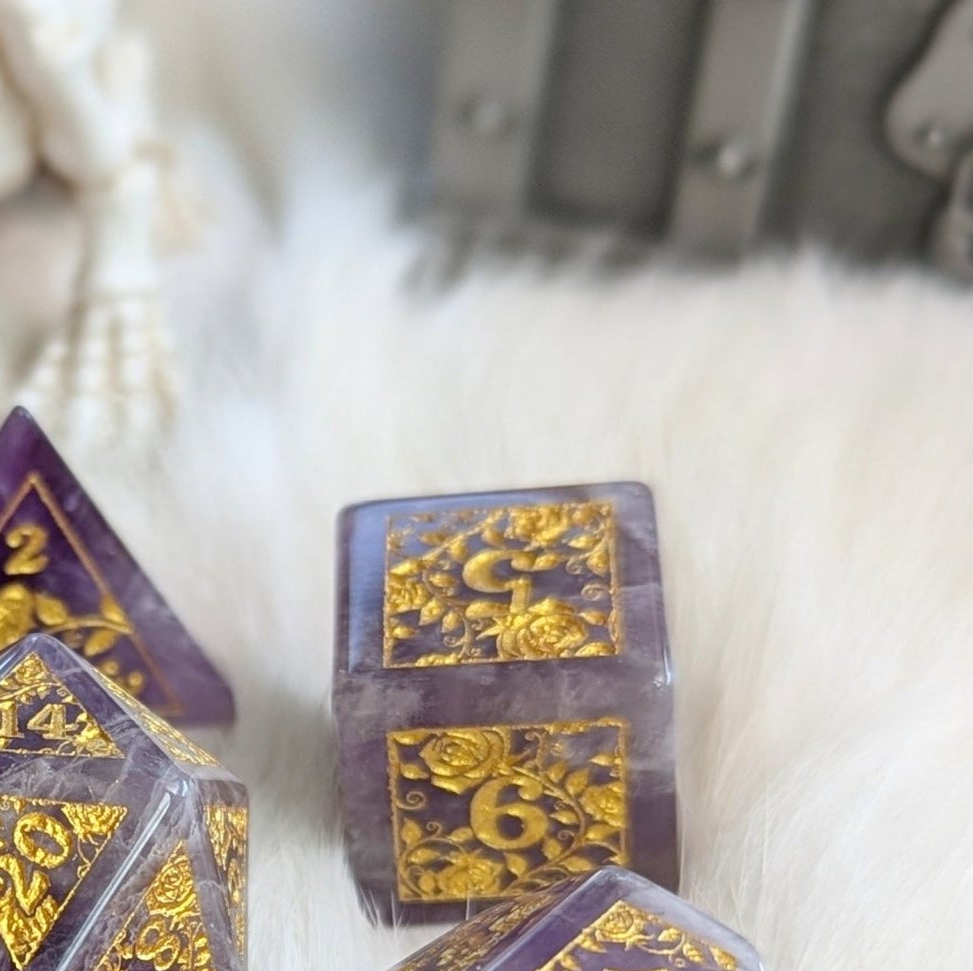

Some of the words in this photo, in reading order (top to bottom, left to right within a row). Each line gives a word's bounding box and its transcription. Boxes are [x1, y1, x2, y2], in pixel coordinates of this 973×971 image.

[4, 523, 48, 575] 2
[462, 549, 535, 618] 5
[469, 774, 549, 850] 6
[135, 917, 181, 971] 8
